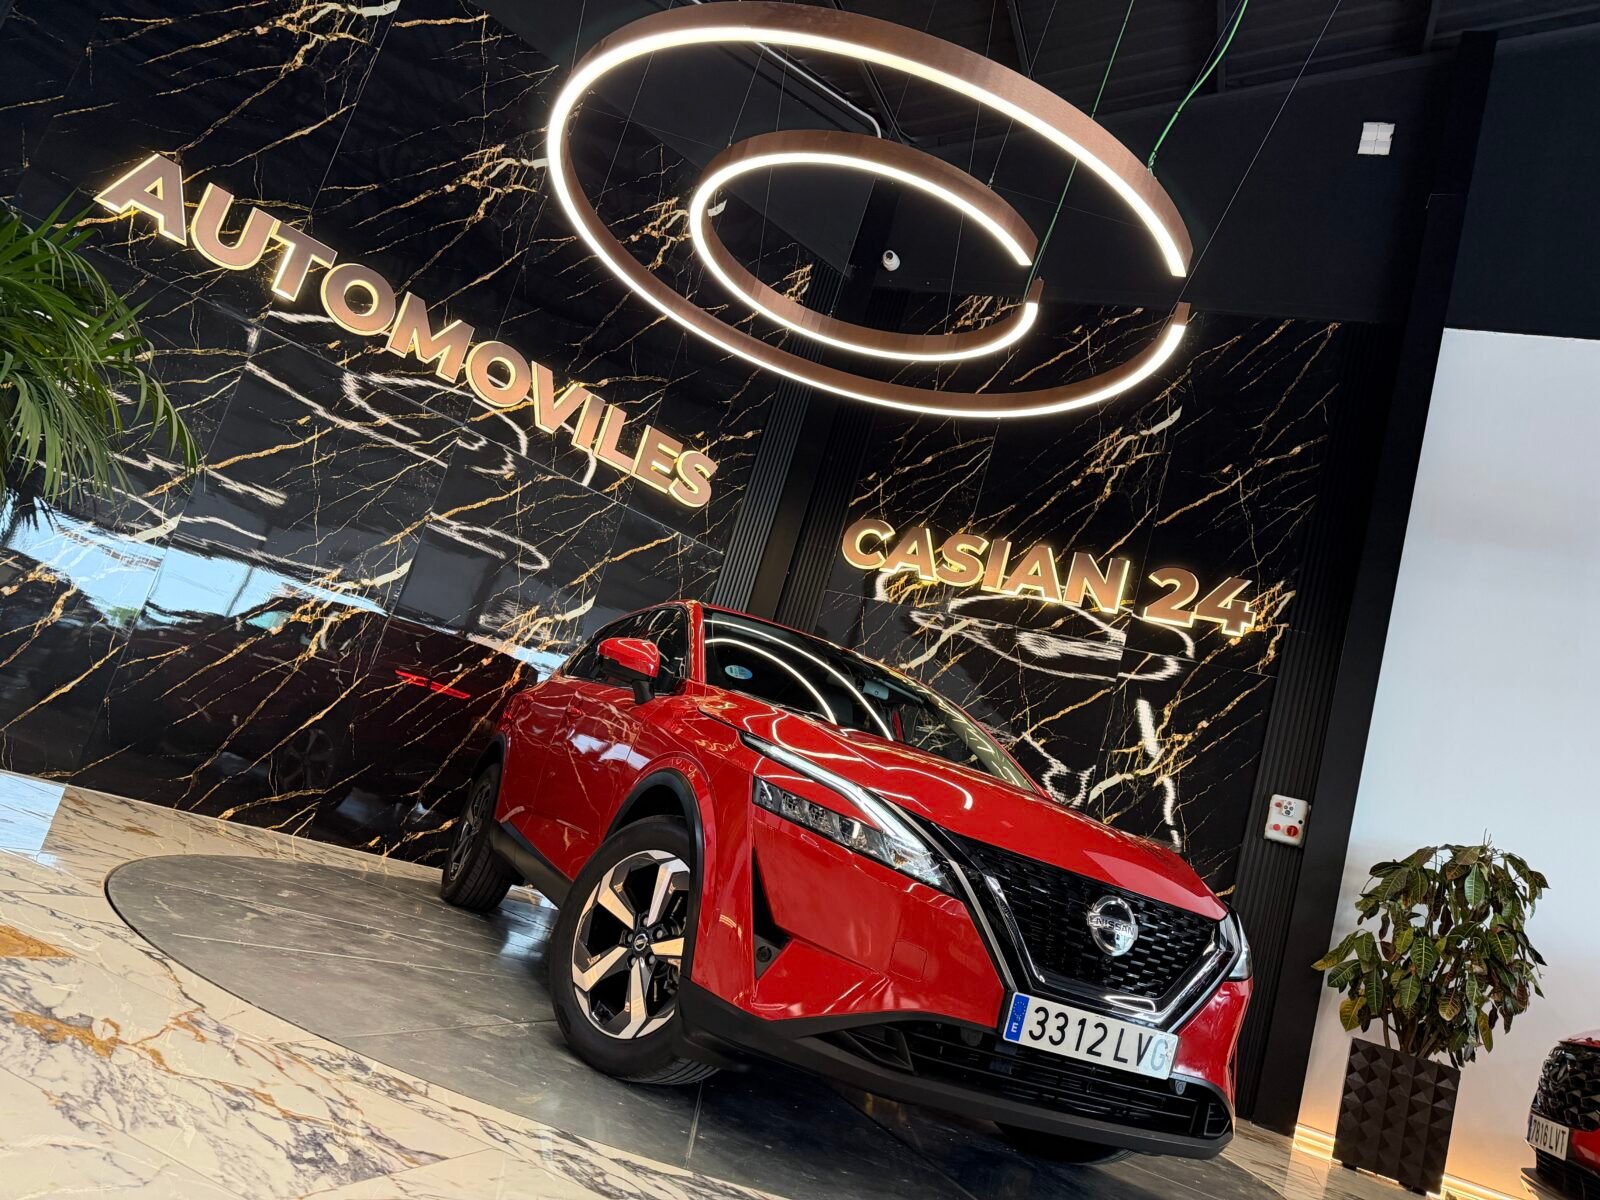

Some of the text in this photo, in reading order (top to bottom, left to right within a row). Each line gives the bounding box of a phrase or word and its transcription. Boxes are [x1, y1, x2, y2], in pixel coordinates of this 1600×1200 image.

[93, 153, 719, 507] AUTOMOVILES
[842, 518, 1257, 637] CASIAN 24
[1096, 918, 1135, 936] NISSAN
